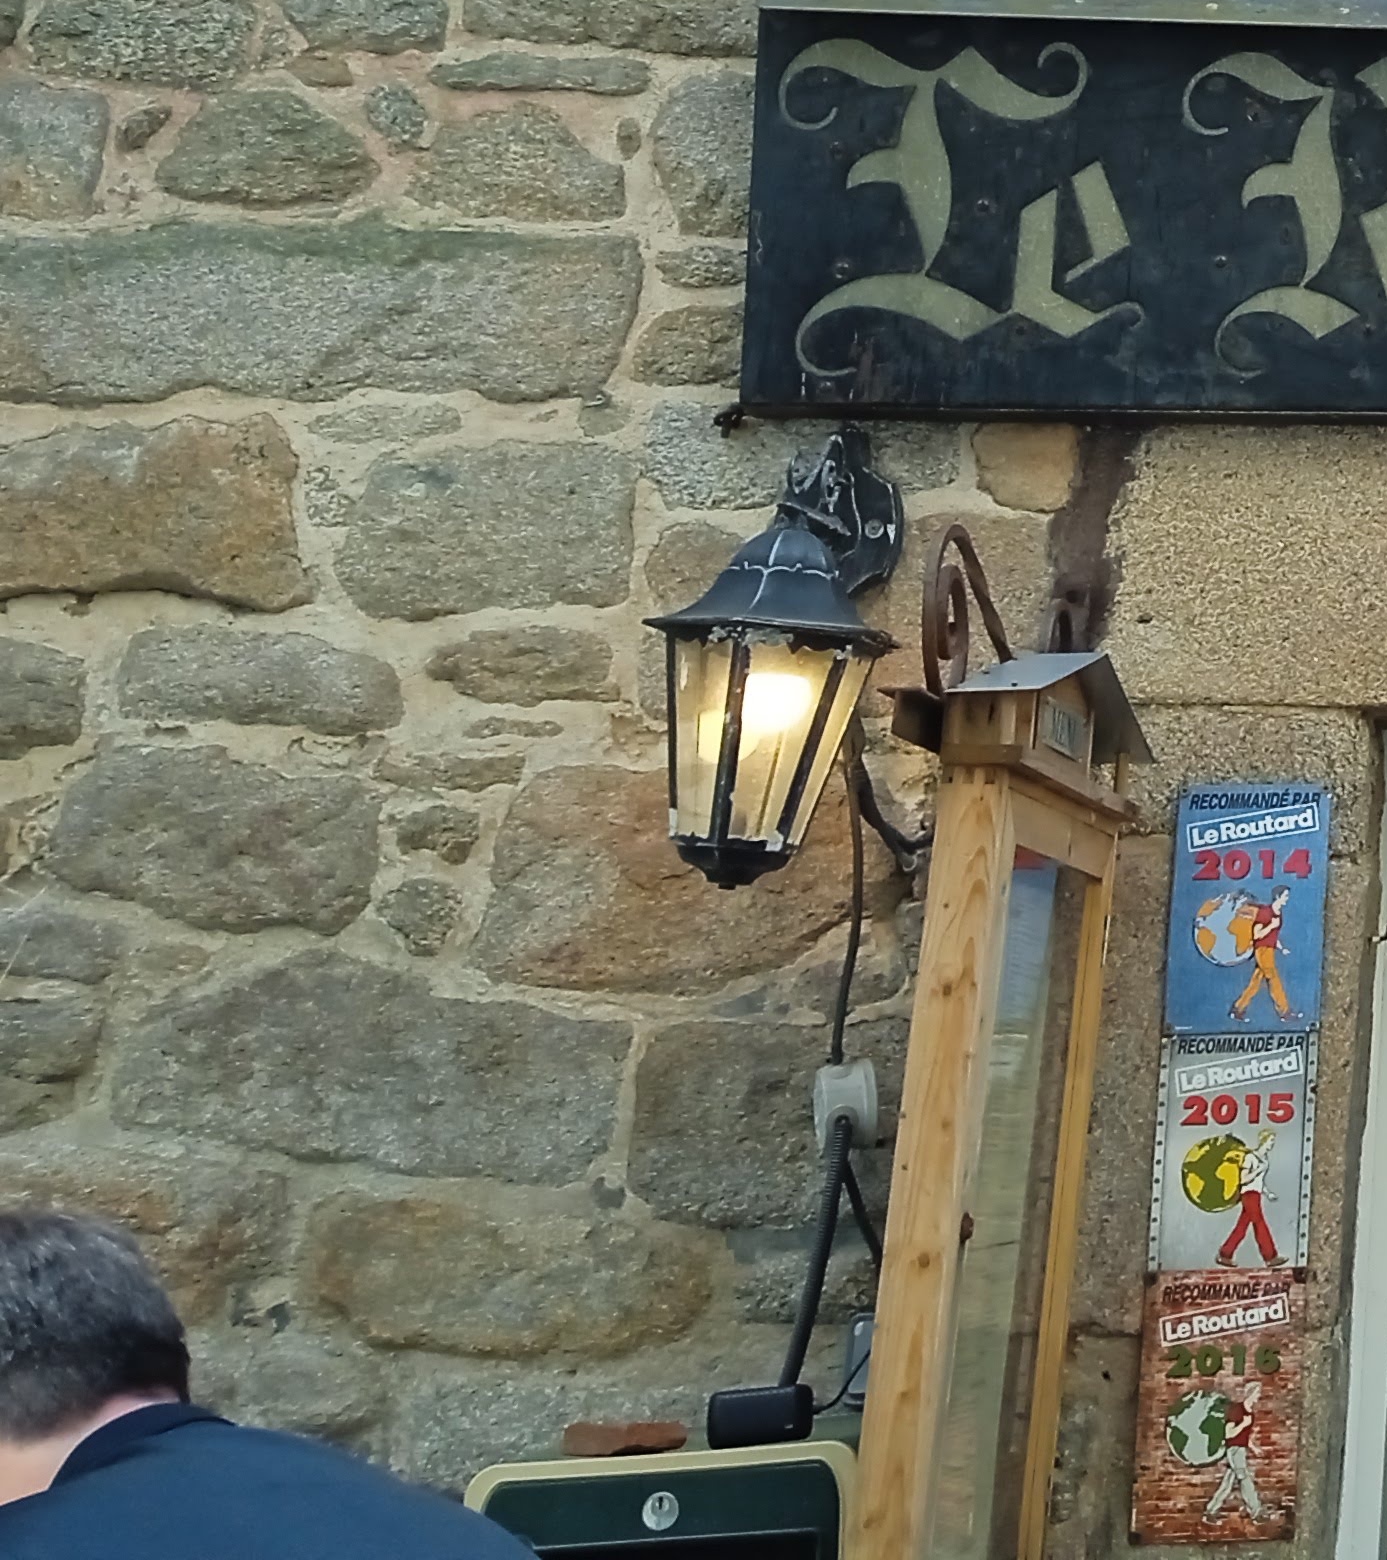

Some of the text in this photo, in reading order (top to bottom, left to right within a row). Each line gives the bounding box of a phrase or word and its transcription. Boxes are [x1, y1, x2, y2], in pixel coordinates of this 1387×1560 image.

[779, 37, 1146, 378] Le
[1189, 789, 1322, 811] RECOMMANDÉ PAR
[1192, 848, 1313, 881] 2014
[1177, 1034, 1305, 1055] RECOMMANDÉ PAR
[1180, 1093, 1296, 1126] 2015
[1163, 1343, 1282, 1378] 2016
